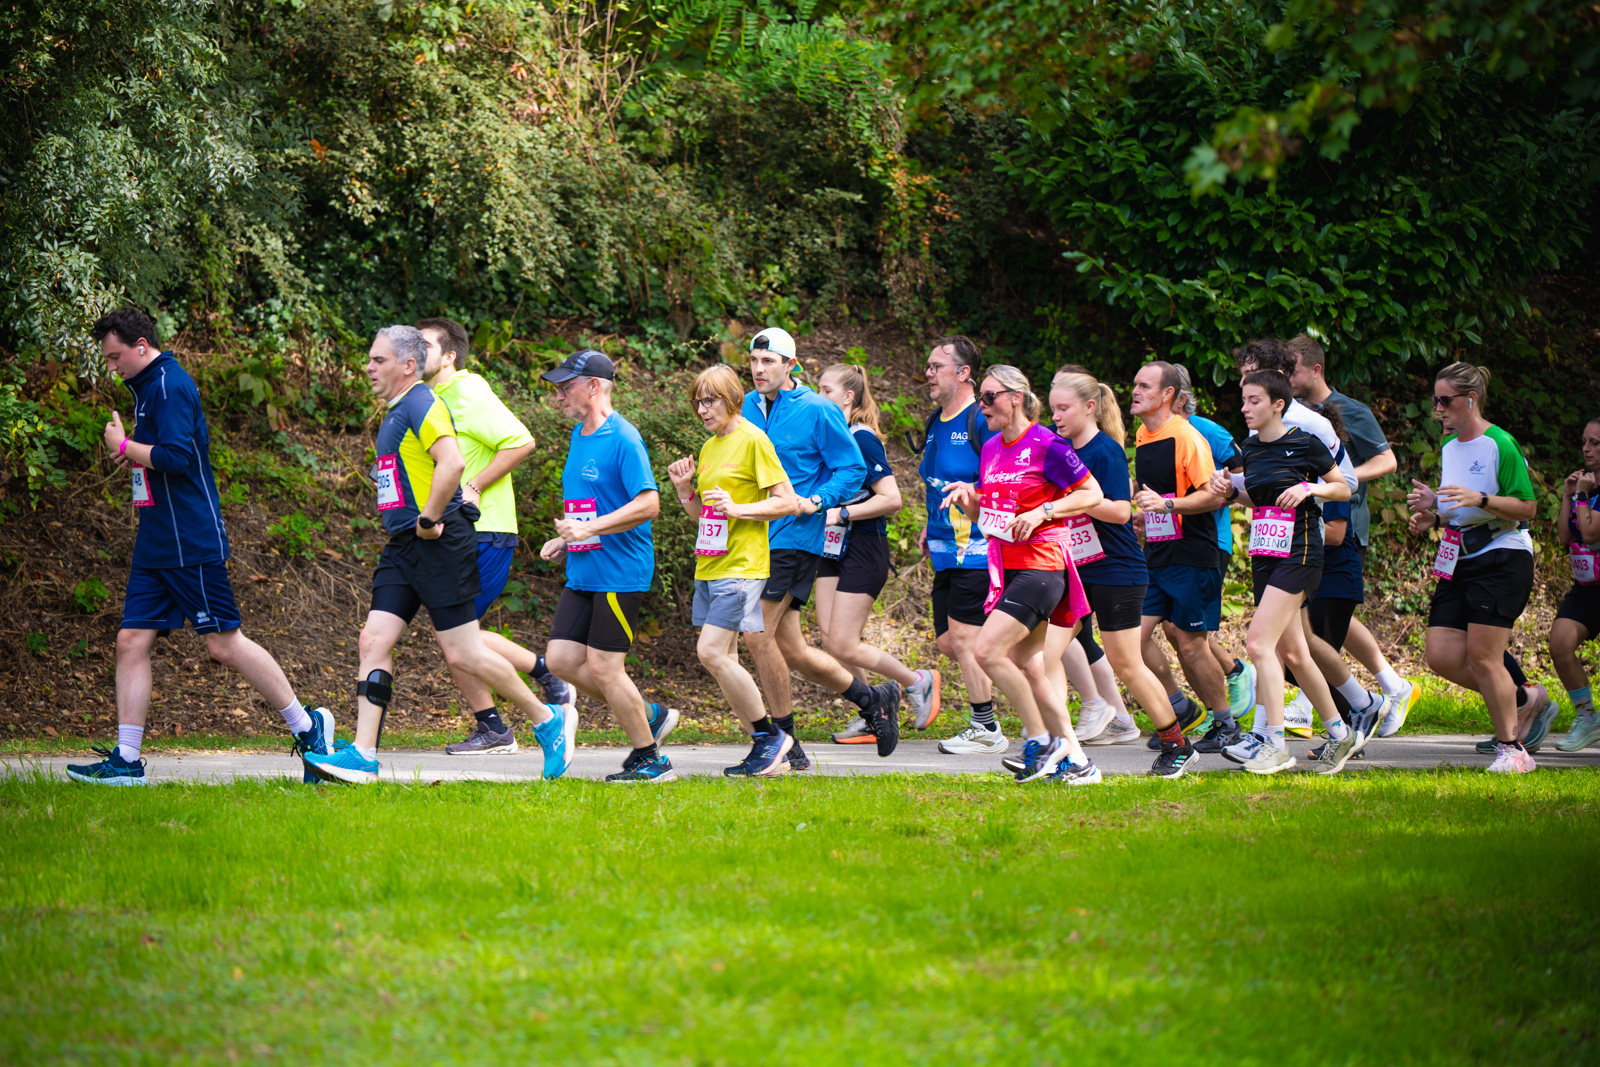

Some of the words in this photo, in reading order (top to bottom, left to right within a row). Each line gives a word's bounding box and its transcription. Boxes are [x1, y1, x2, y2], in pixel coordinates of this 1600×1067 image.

[951, 432, 968, 440] DAG
[132, 473, 142, 486] 48
[983, 511, 1008, 529] 7706
[825, 530, 841, 544] 156
[1255, 523, 1287, 538] 19003
[1071, 530, 1092, 546] 533
[1573, 559, 1589, 571] 403
